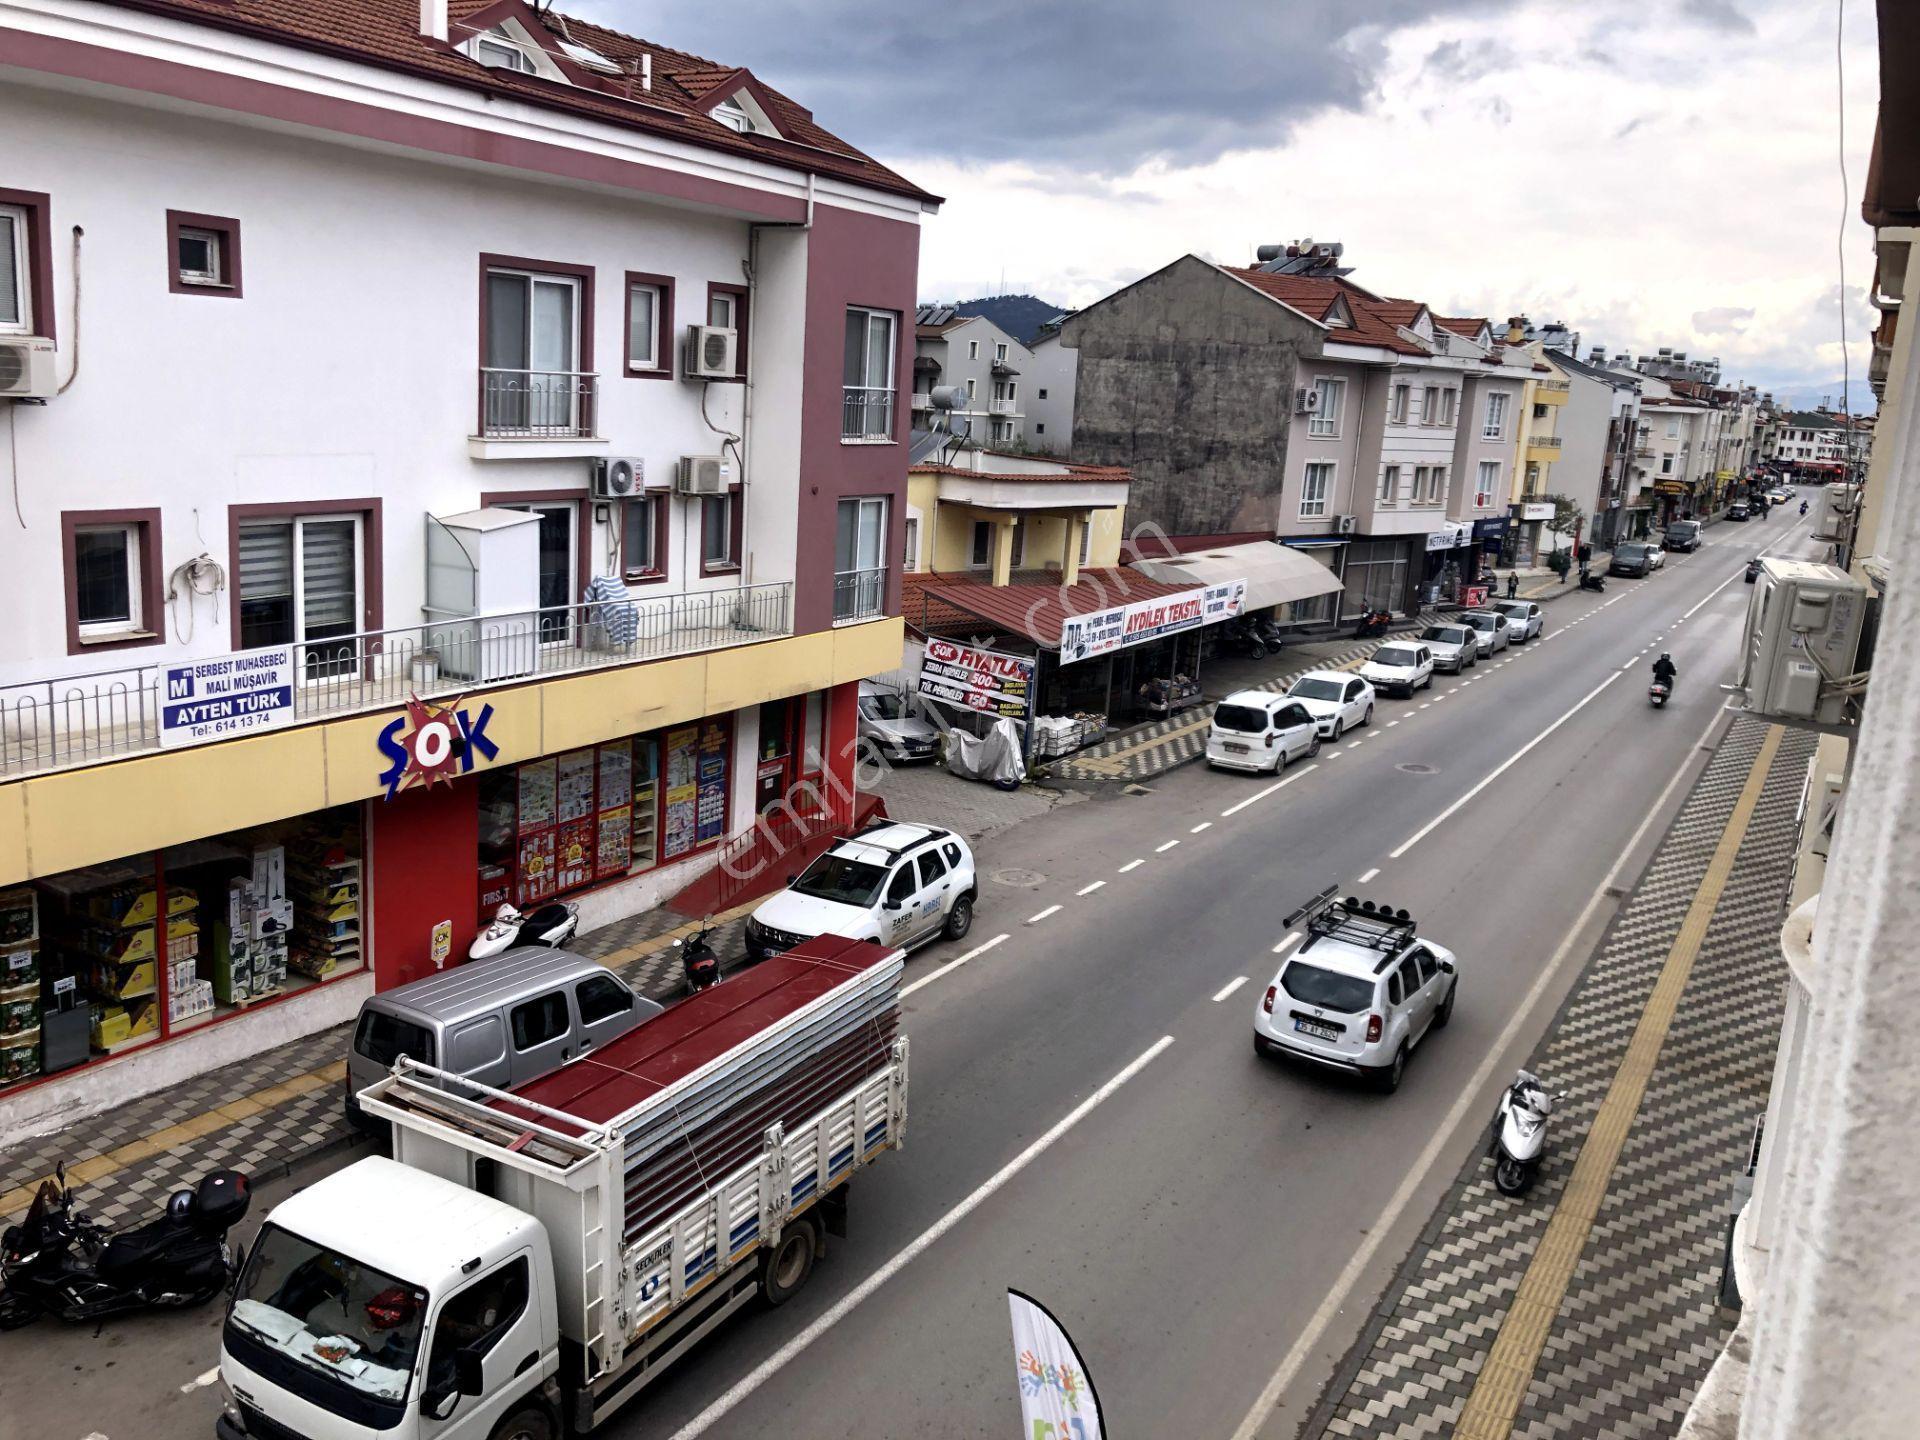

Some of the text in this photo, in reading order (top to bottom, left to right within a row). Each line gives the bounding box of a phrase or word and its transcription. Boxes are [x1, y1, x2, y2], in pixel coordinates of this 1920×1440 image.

[1126, 594, 1201, 634] AYDİLEK TEKSTİL
[195, 650, 287, 679] SERBEST MUHASEBECİ
[206, 670, 278, 695] MALİ MÜŞAVİR
[971, 672, 993, 688] 500
[177, 691, 281, 725] AYTEN TÜRK
[932, 685, 964, 702] PERDELER
[968, 693, 988, 708] 150
[190, 712, 270, 737] Tel: 614 13 74
[378, 703, 500, 803] ŞOK
[483, 886, 510, 907] FIRST
[892, 911, 913, 927] ZAFER
